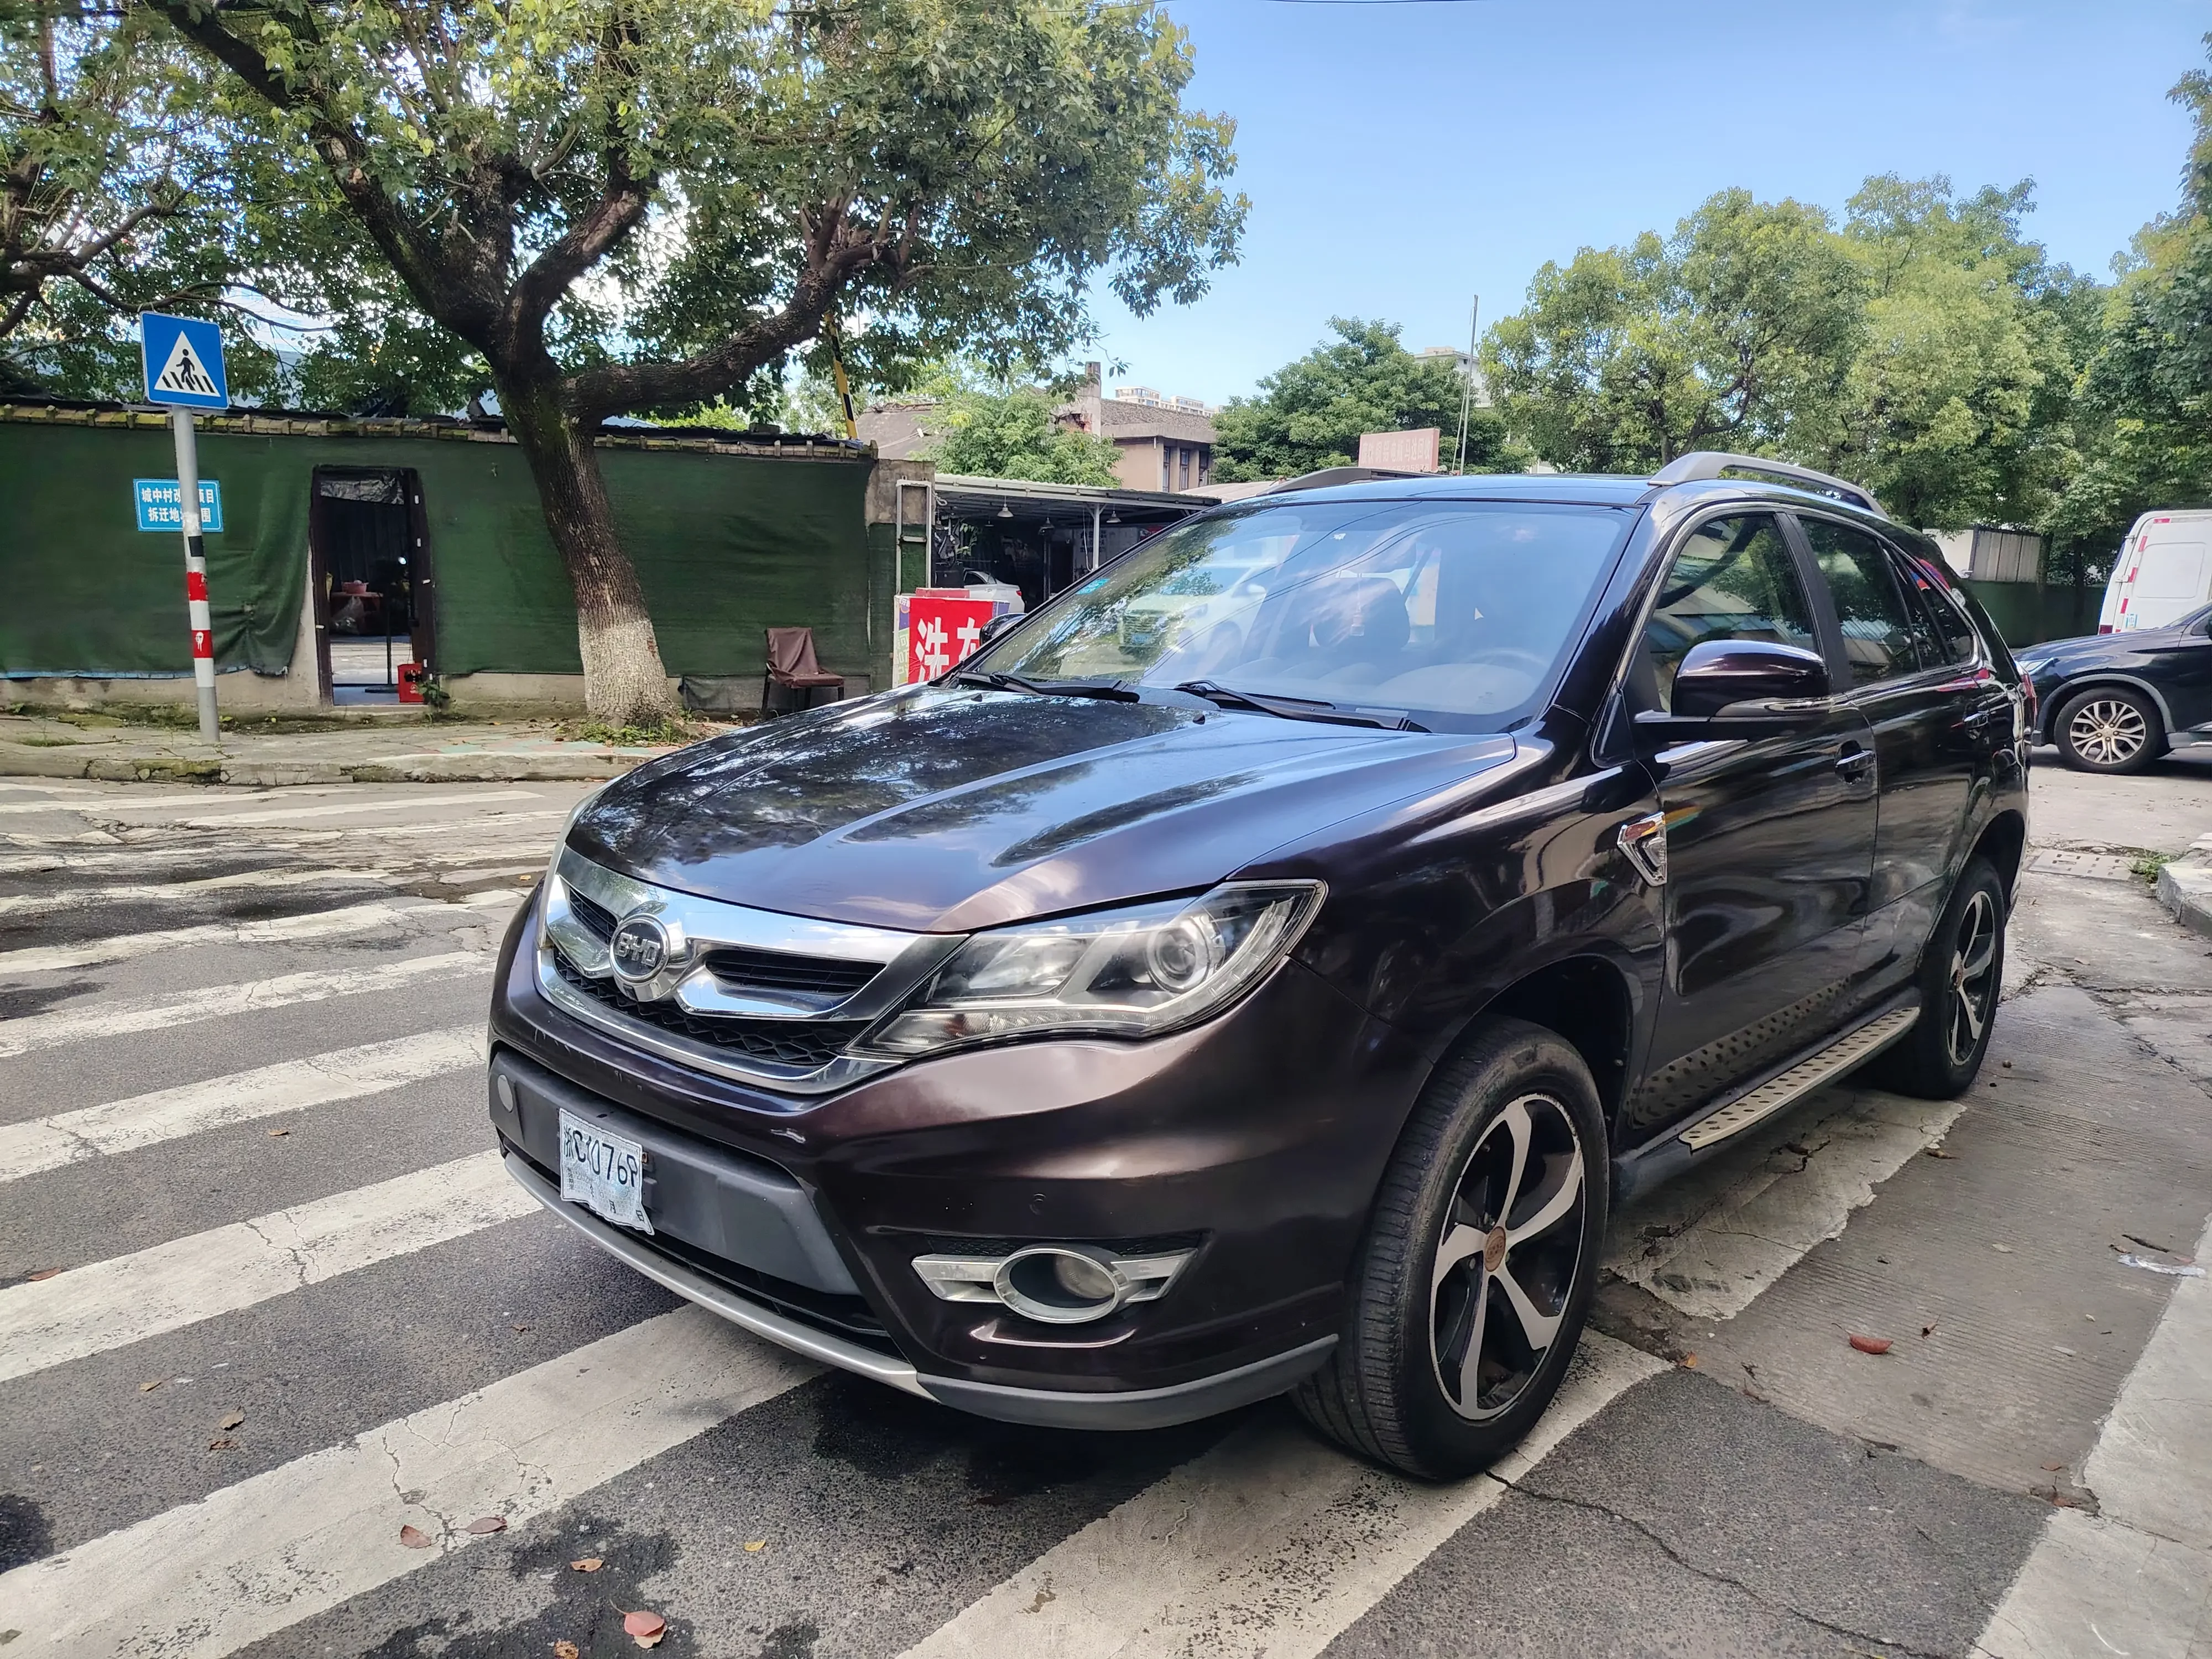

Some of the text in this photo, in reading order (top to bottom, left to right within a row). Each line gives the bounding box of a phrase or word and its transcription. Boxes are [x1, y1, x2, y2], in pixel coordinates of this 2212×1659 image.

[142, 487, 215, 504] 城中村改项目
[148, 507, 211, 523] 拆迁地围
[615, 932, 660, 967] BYD
